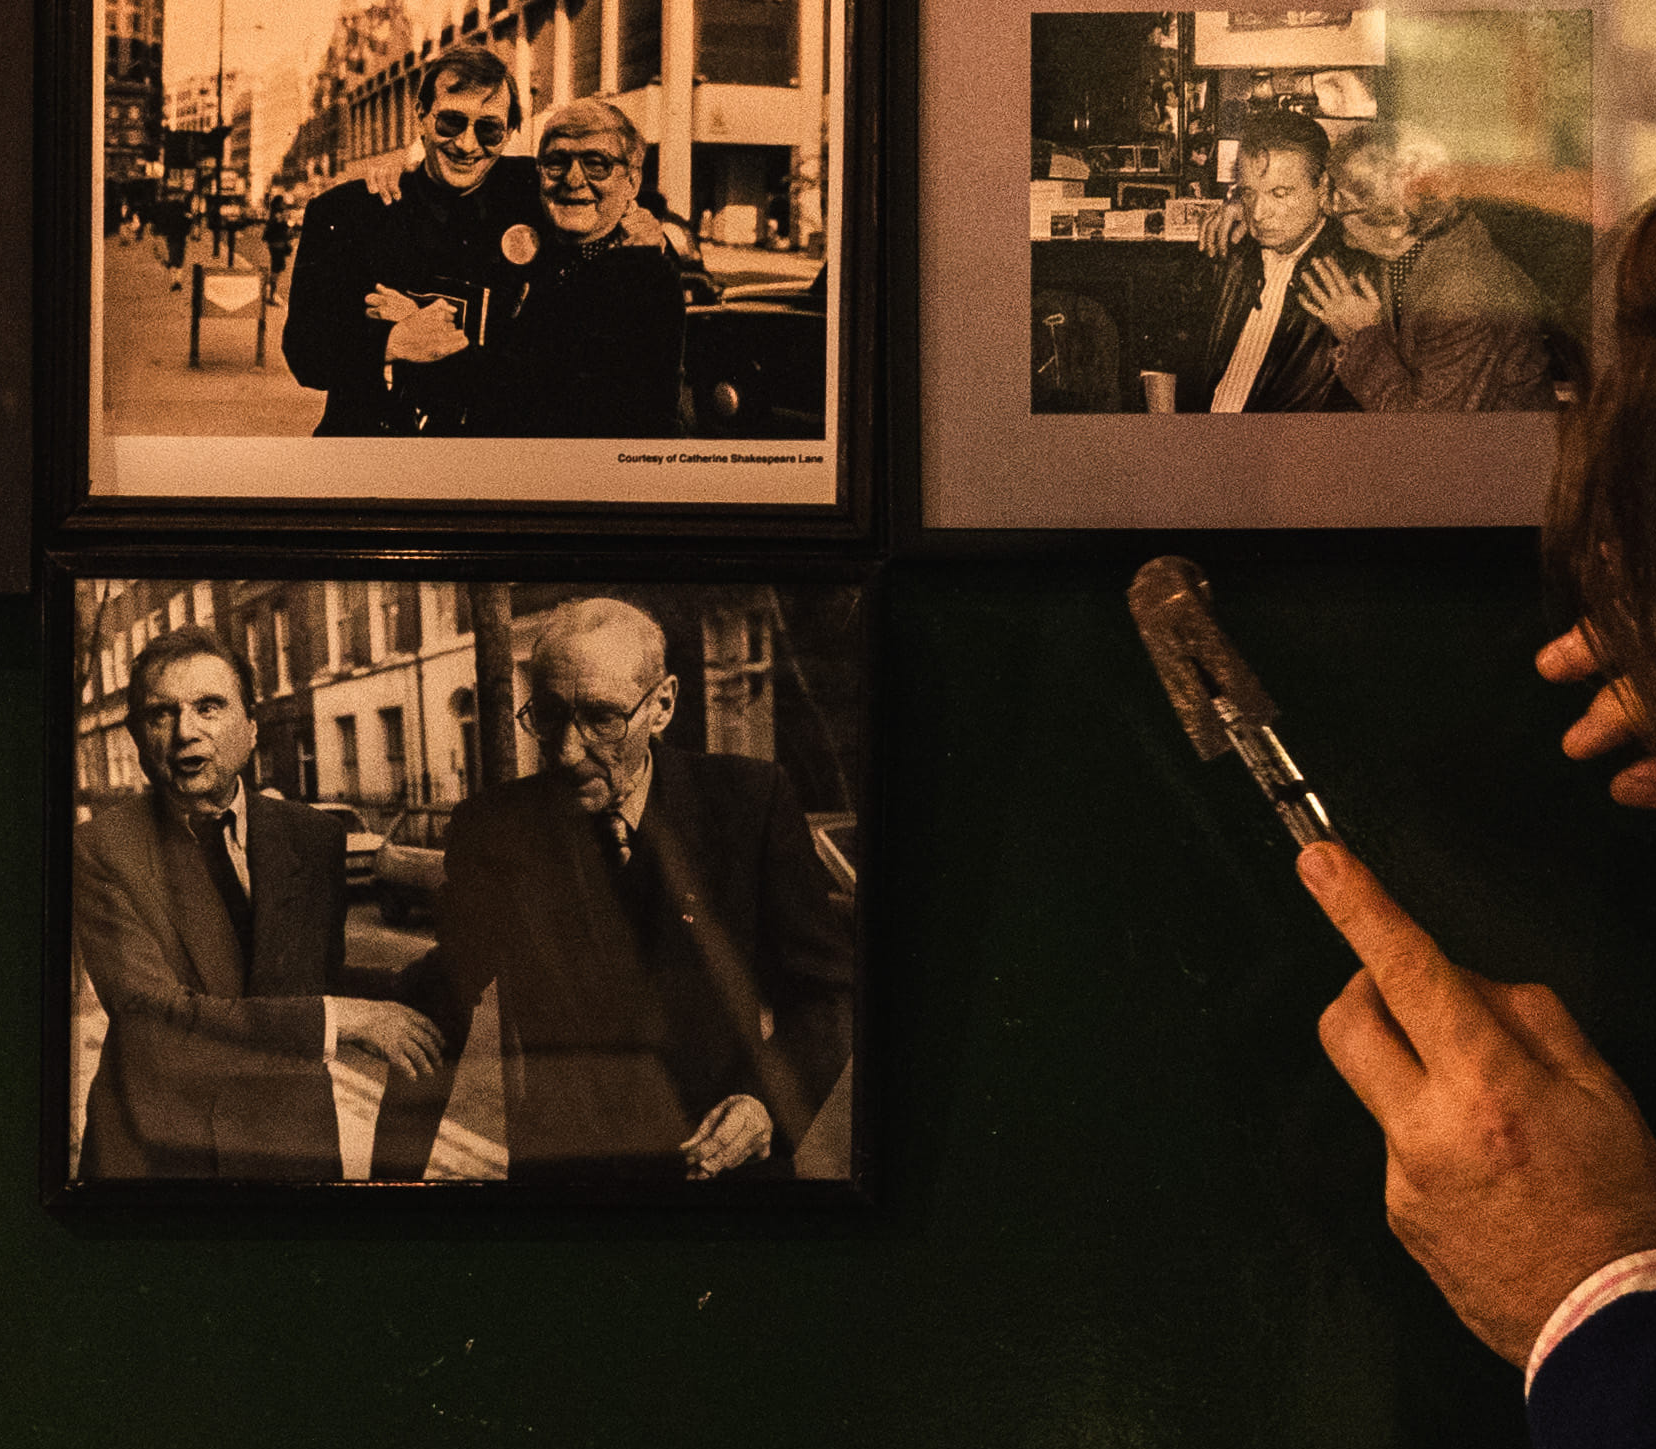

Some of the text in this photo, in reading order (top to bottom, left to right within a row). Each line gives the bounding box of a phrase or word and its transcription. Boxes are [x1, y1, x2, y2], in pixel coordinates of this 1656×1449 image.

[617, 453, 824, 465] Courtesy of Catherine Shakespeare Lane
